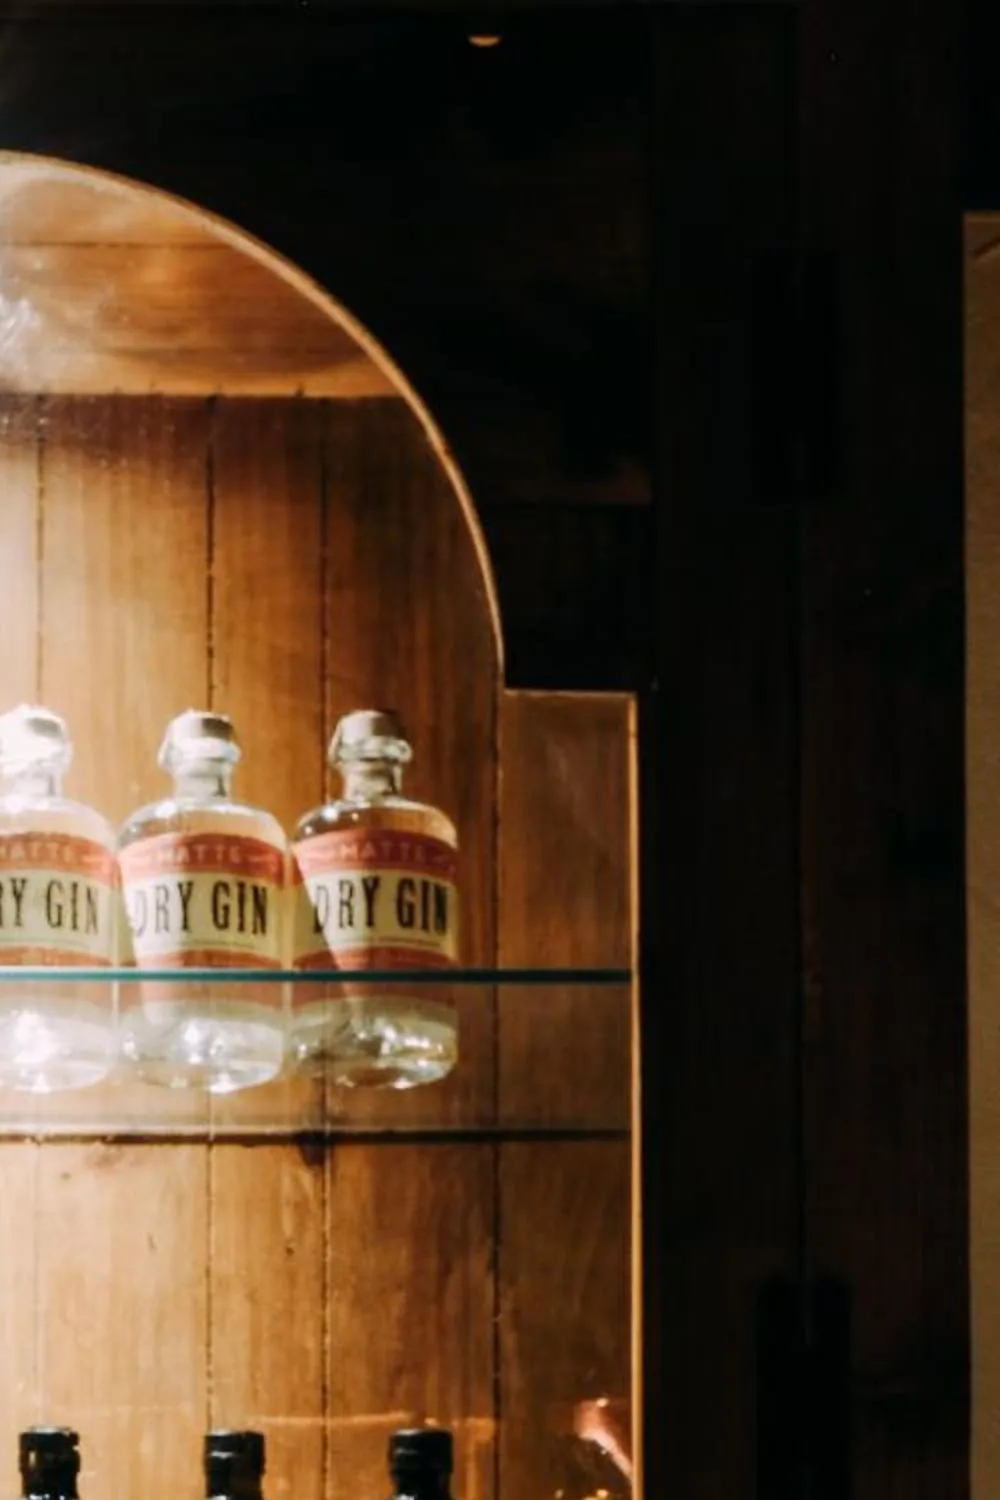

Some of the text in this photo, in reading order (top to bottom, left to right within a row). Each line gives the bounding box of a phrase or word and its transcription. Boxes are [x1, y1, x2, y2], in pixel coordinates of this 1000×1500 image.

[45, 880, 98, 935] GIN
[135, 880, 267, 938] DRY GIN
[313, 876, 447, 935] DRY GIN
